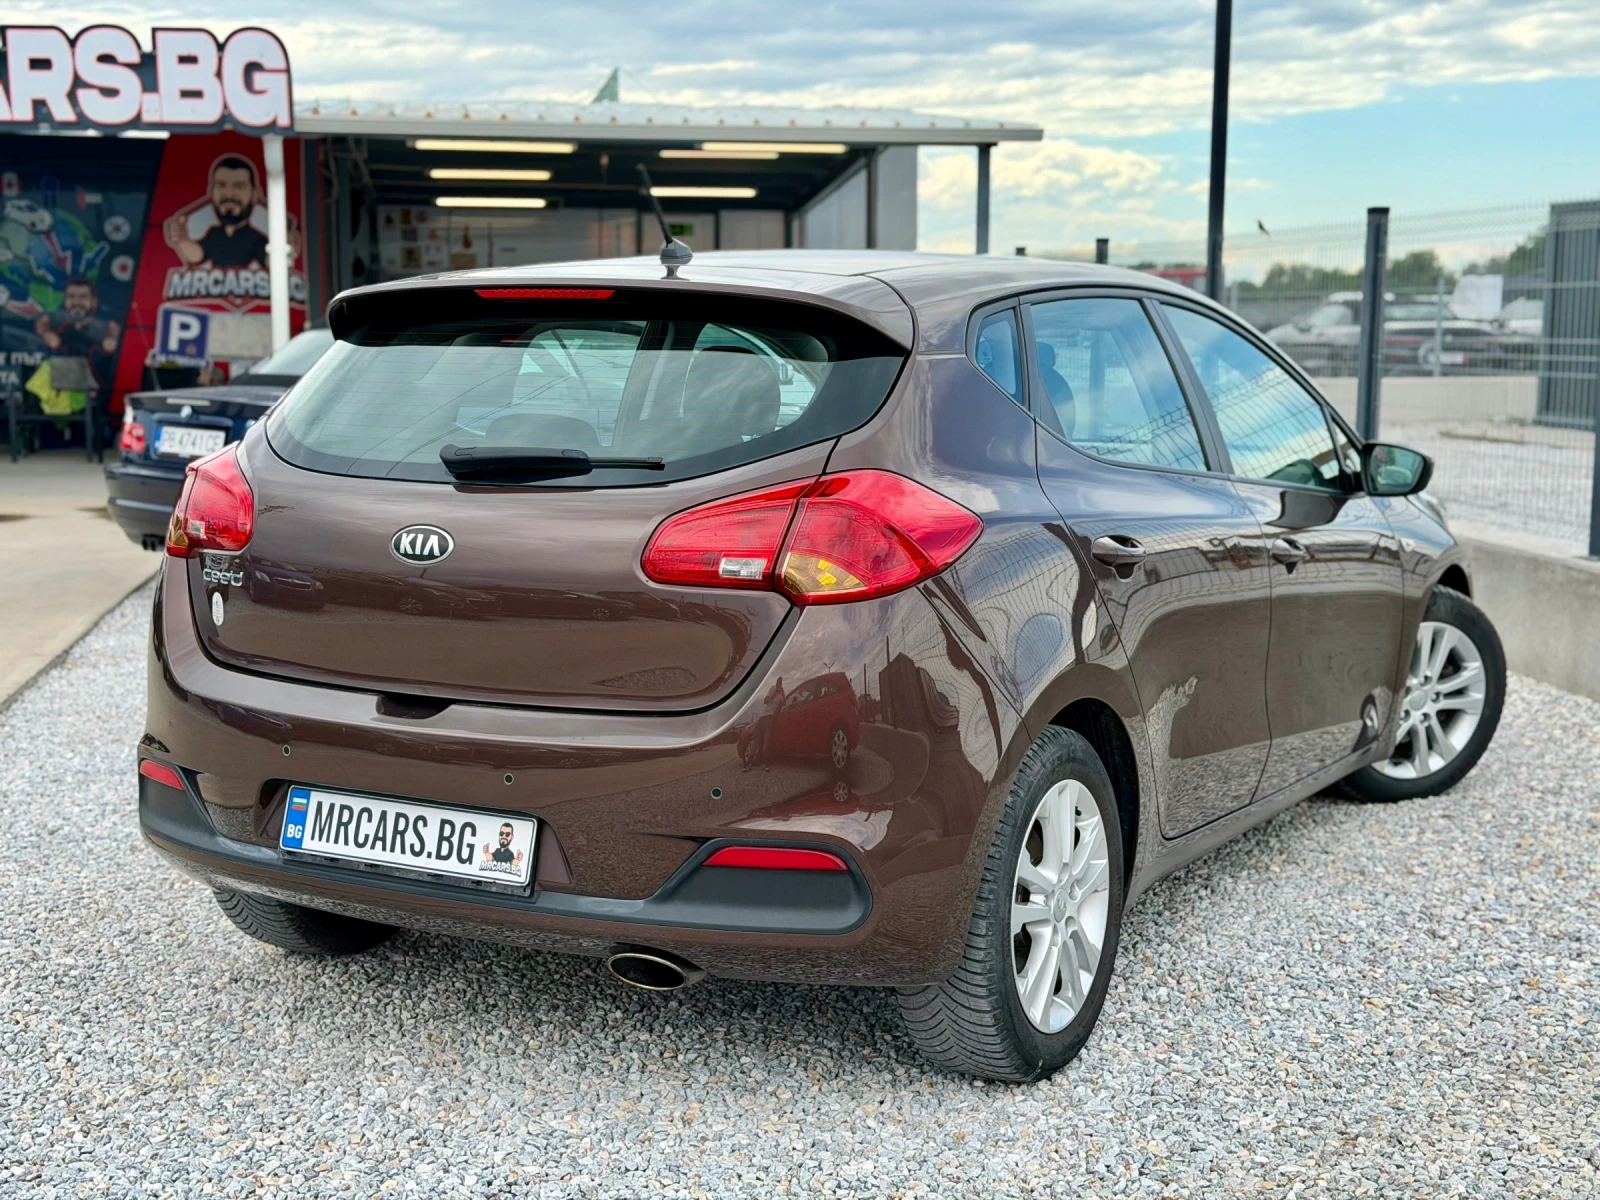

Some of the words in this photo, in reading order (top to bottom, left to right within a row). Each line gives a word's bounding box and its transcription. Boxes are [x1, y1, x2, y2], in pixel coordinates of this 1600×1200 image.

[168, 268, 307, 300] MRCARSG
[168, 313, 202, 352] P
[400, 532, 441, 556] KIA
[286, 823, 303, 839] BG
[310, 800, 477, 865] MRCARS.BG
